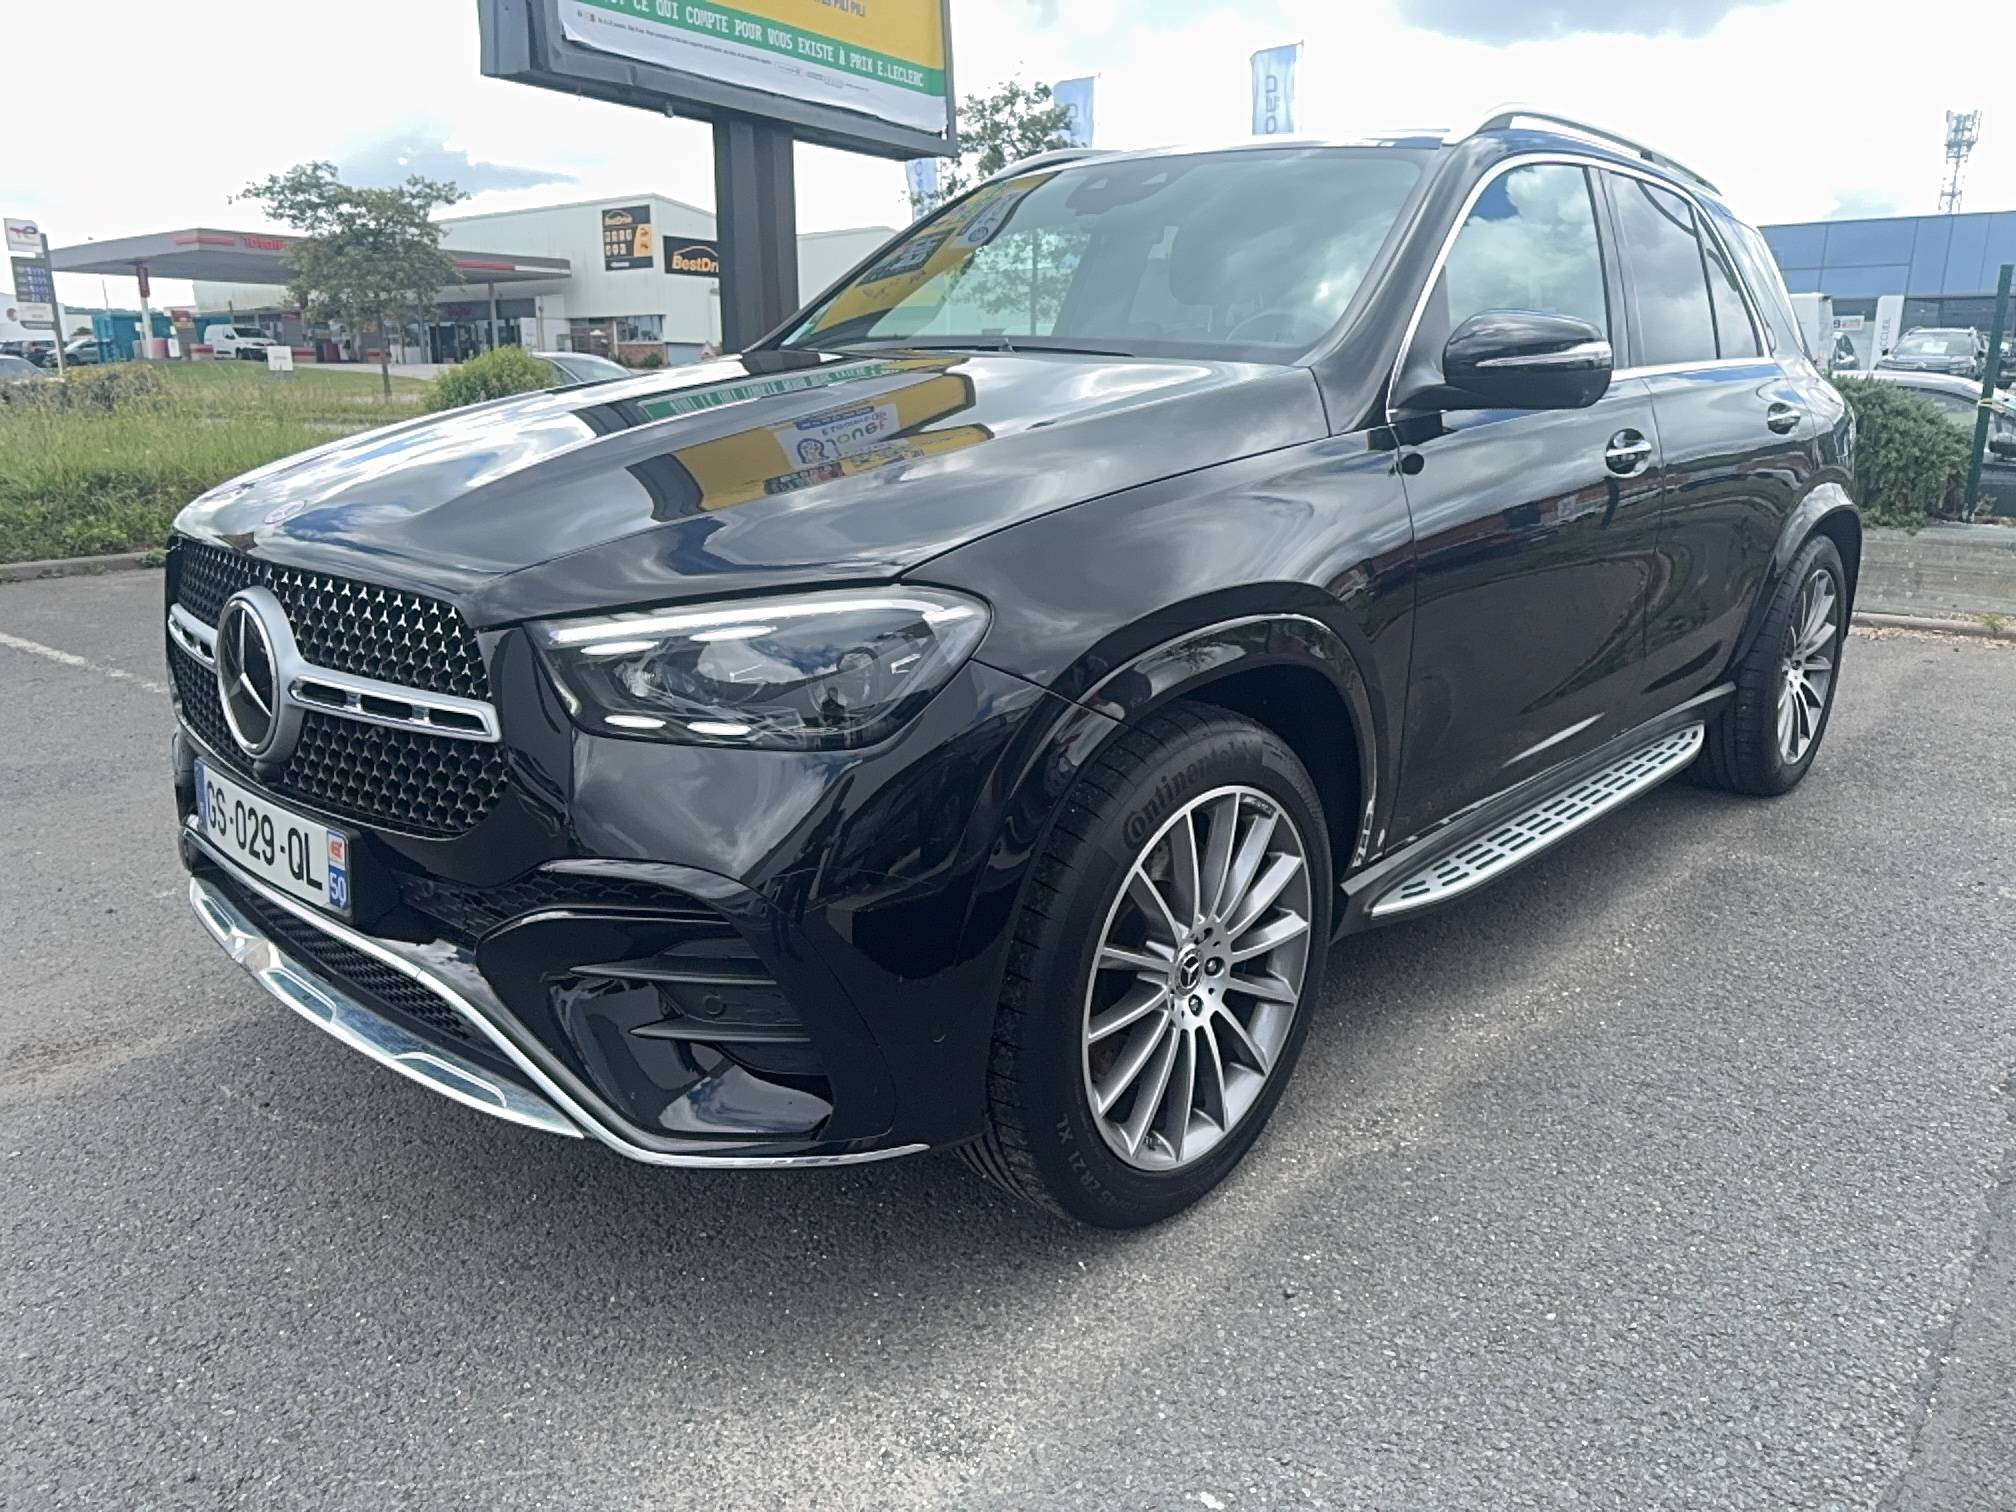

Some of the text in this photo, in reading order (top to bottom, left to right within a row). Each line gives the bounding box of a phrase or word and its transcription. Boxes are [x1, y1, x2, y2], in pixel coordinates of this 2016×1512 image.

[656, 0, 679, 19] QUI
[686, 6, 729, 33] COMPTE
[735, 19, 762, 41] POUR
[768, 28, 793, 49] VOUS
[798, 37, 834, 62] EXISTE
[850, 53, 874, 74] PRIX
[877, 61, 924, 87] E.LECLERC
[206, 779, 323, 892] GS-029-QL
[329, 871, 347, 906] 50
